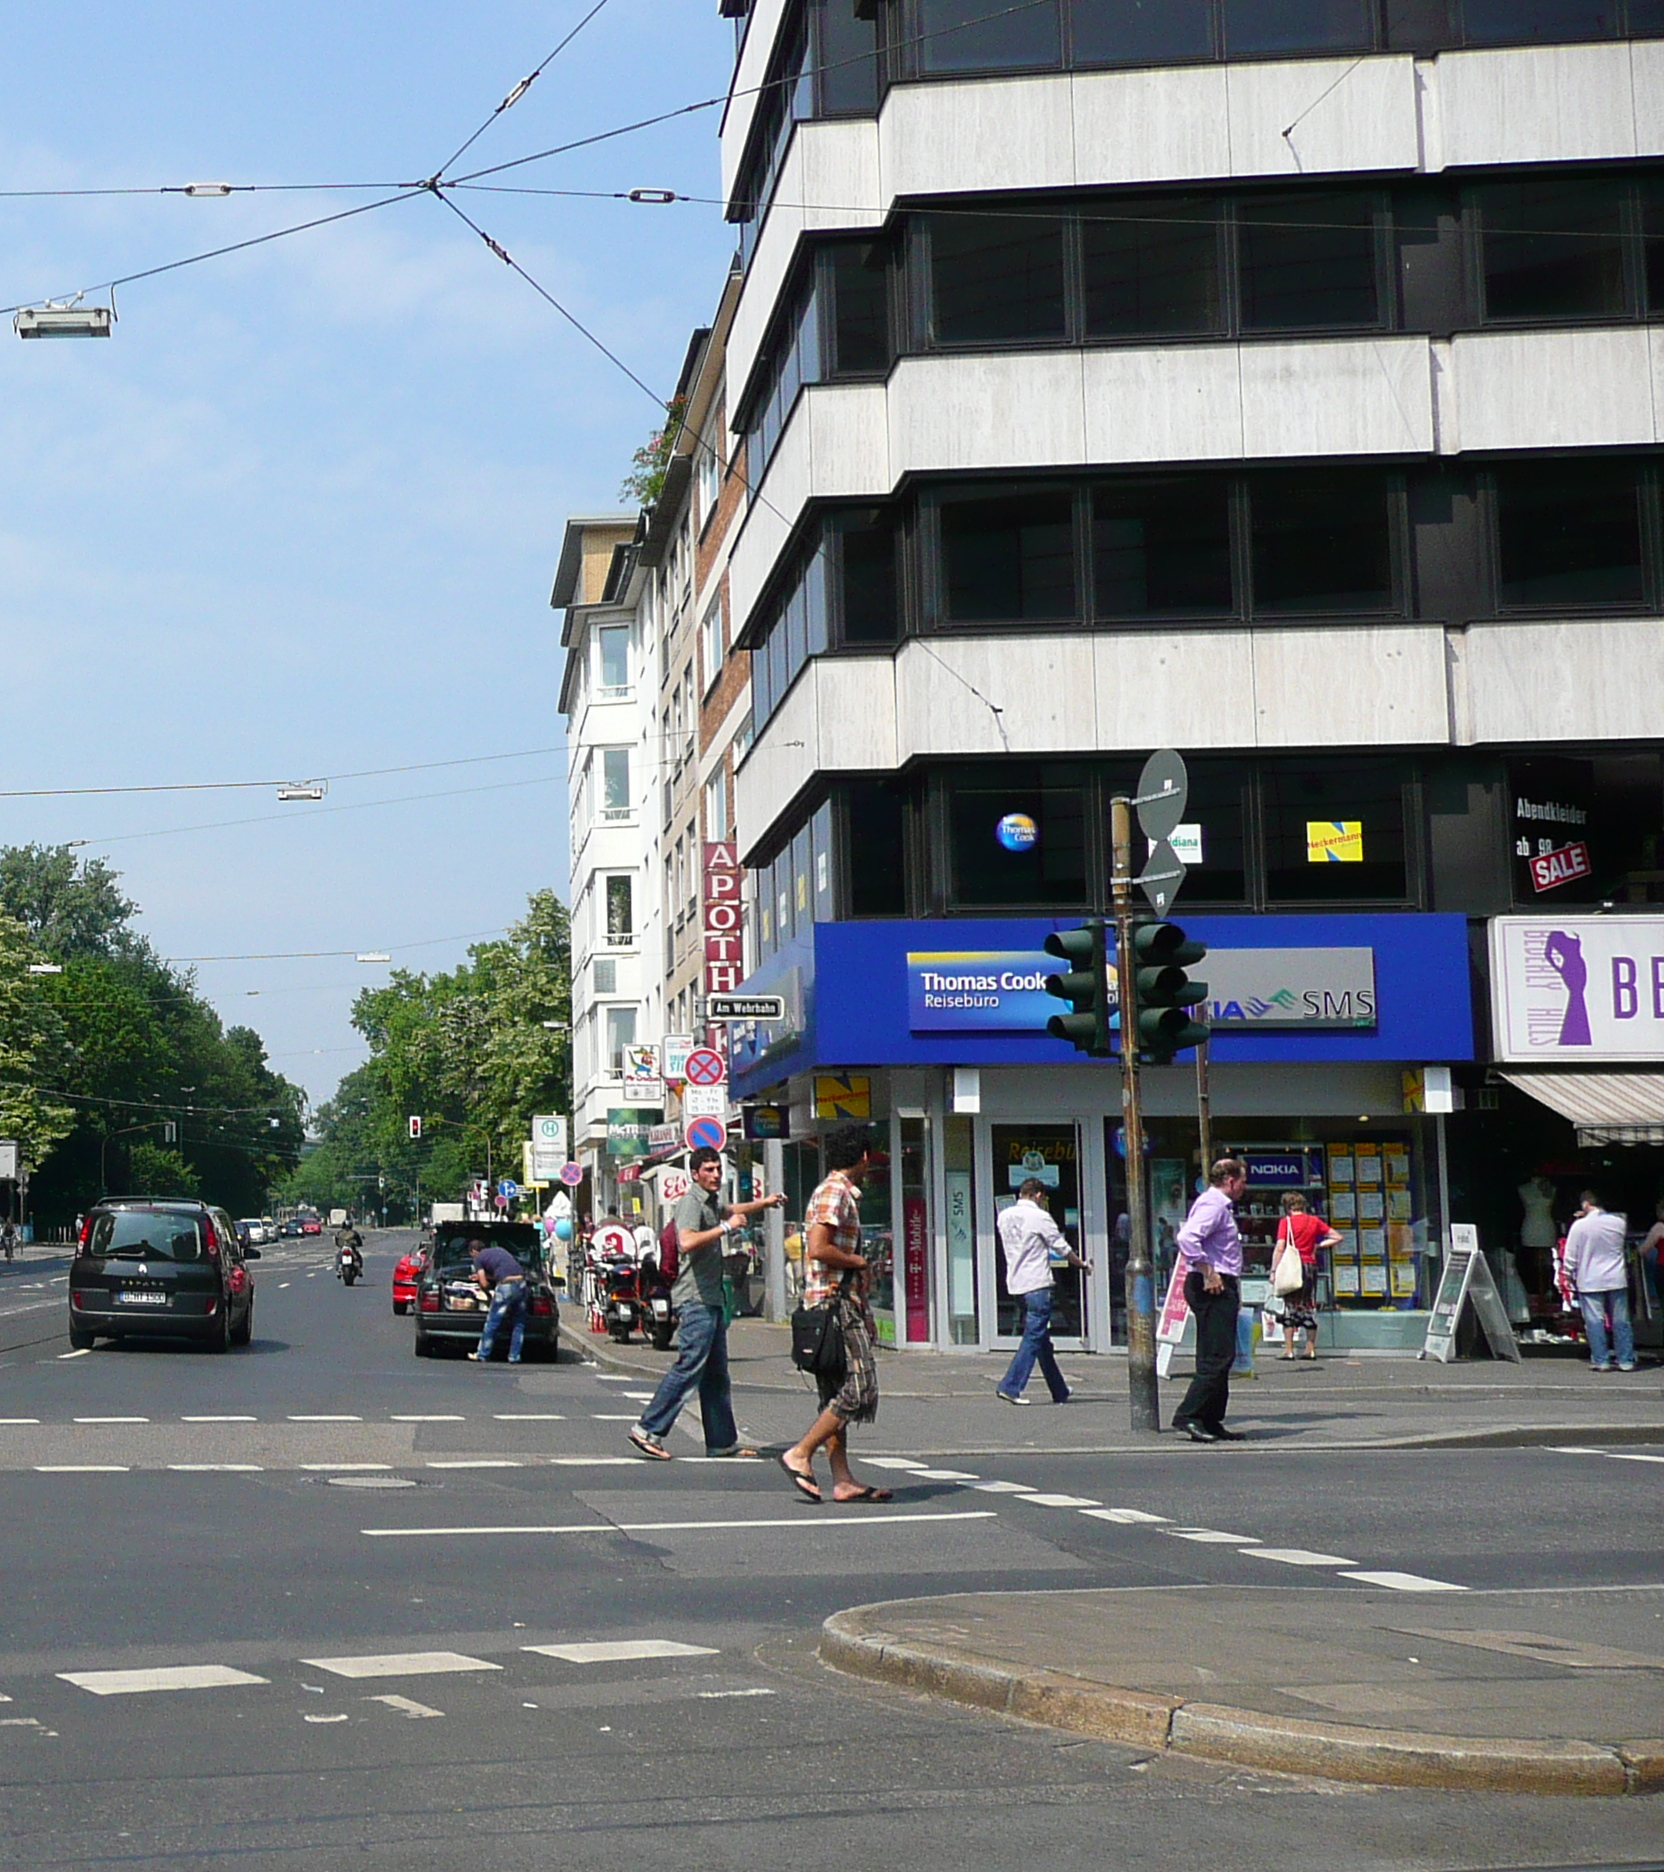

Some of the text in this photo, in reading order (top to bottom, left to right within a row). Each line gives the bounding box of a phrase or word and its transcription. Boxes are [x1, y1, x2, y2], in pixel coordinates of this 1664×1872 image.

[1517, 797, 1587, 825] Abendkleider
[1002, 825, 1036, 834] Thomas
[1014, 834, 1035, 842] Cook
[1516, 836, 1530, 856] ab
[1536, 847, 1586, 886] SALE
[708, 844, 736, 1084] APOTHK
[920, 972, 1047, 991] Thomas Cook
[716, 1002, 776, 1014] Am Wehrhahn
[925, 994, 1000, 1008] Reisebüro
[1302, 990, 1374, 1018] SMS
[1527, 1008, 1564, 1046] HILLS
[1250, 1164, 1299, 1174] NOKIA
[953, 1191, 964, 1216] SMS
